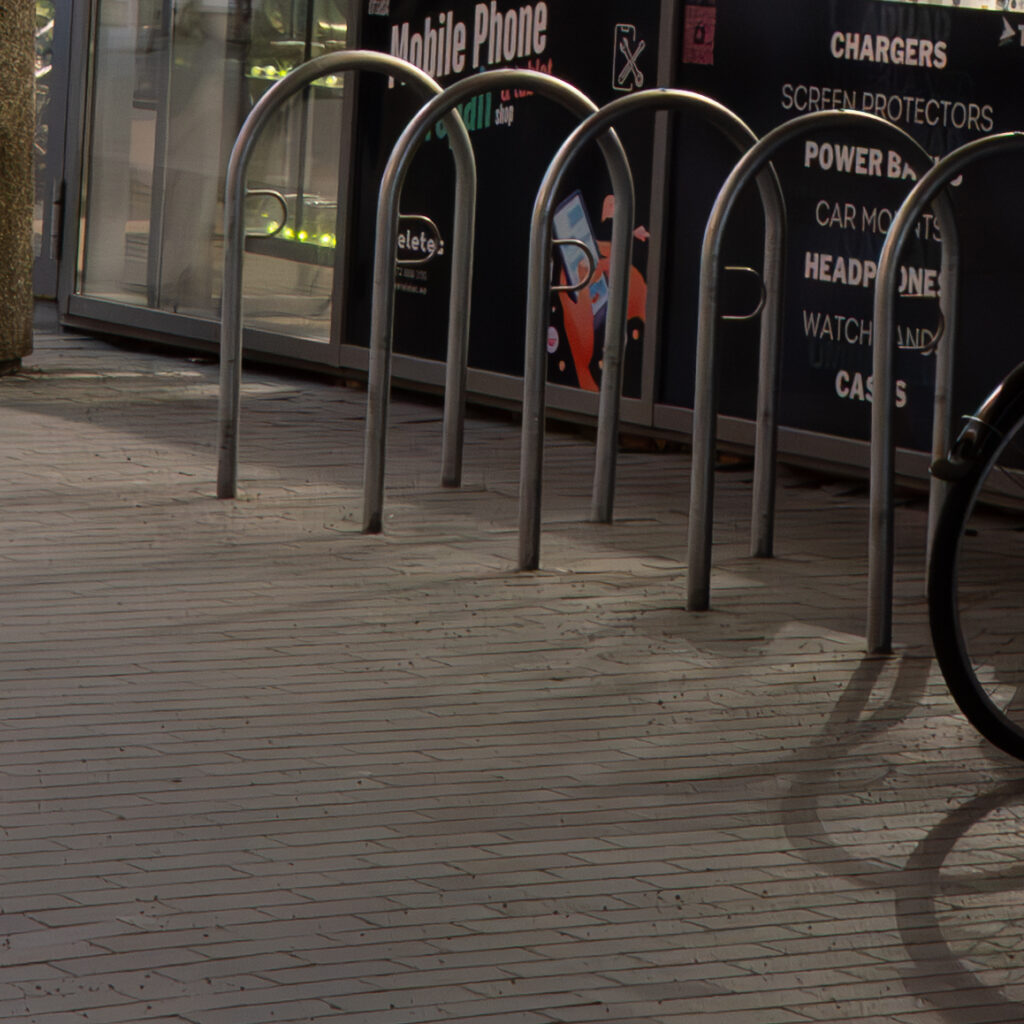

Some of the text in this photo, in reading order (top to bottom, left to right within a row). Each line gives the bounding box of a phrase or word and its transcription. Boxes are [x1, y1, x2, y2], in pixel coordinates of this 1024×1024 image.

[391, 0, 548, 77] Mobile Phone
[830, 30, 948, 70] CHARGERS
[494, 102, 514, 127] shop
[781, 83, 994, 132] SCREEN PROTECTORS
[804, 140, 883, 177] POWER
[815, 199, 856, 230] CAR
[835, 369, 907, 408] CASS
